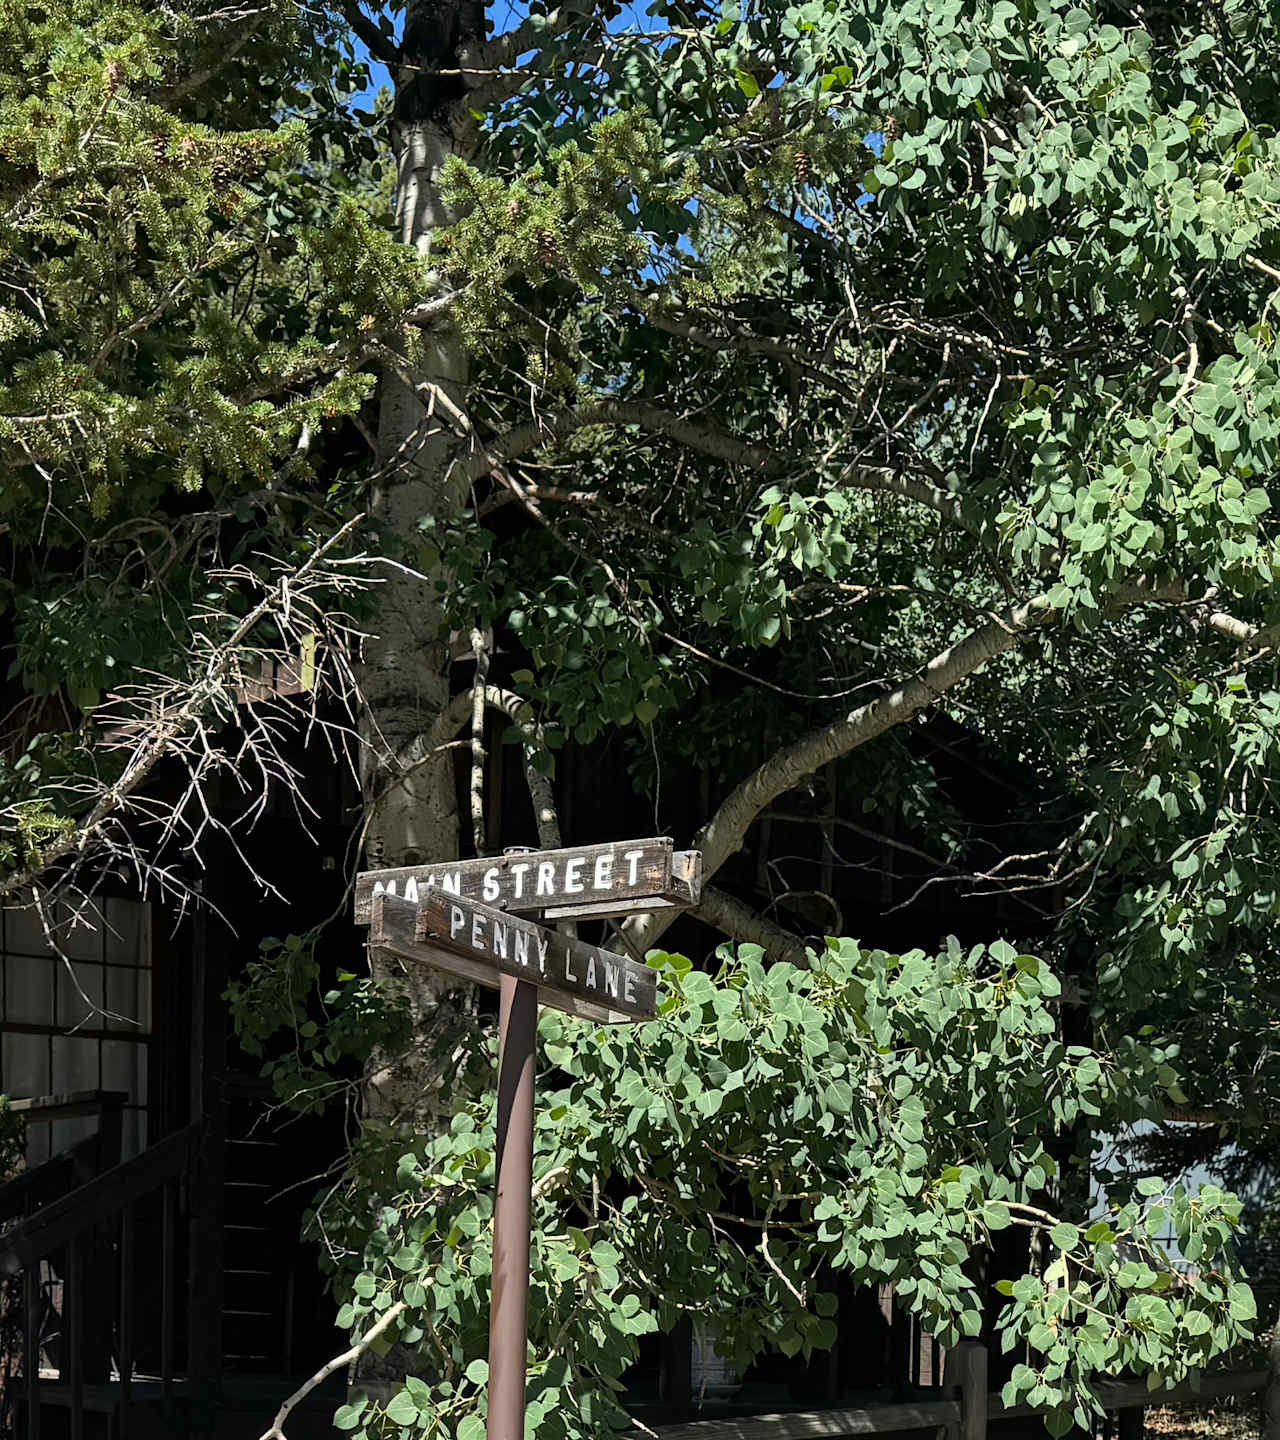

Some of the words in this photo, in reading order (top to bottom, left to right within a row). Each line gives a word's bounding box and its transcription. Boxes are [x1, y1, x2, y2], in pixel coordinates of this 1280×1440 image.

[482, 850, 644, 902] STREET
[450, 905, 549, 973] PENNY
[566, 947, 640, 1004] LANE
